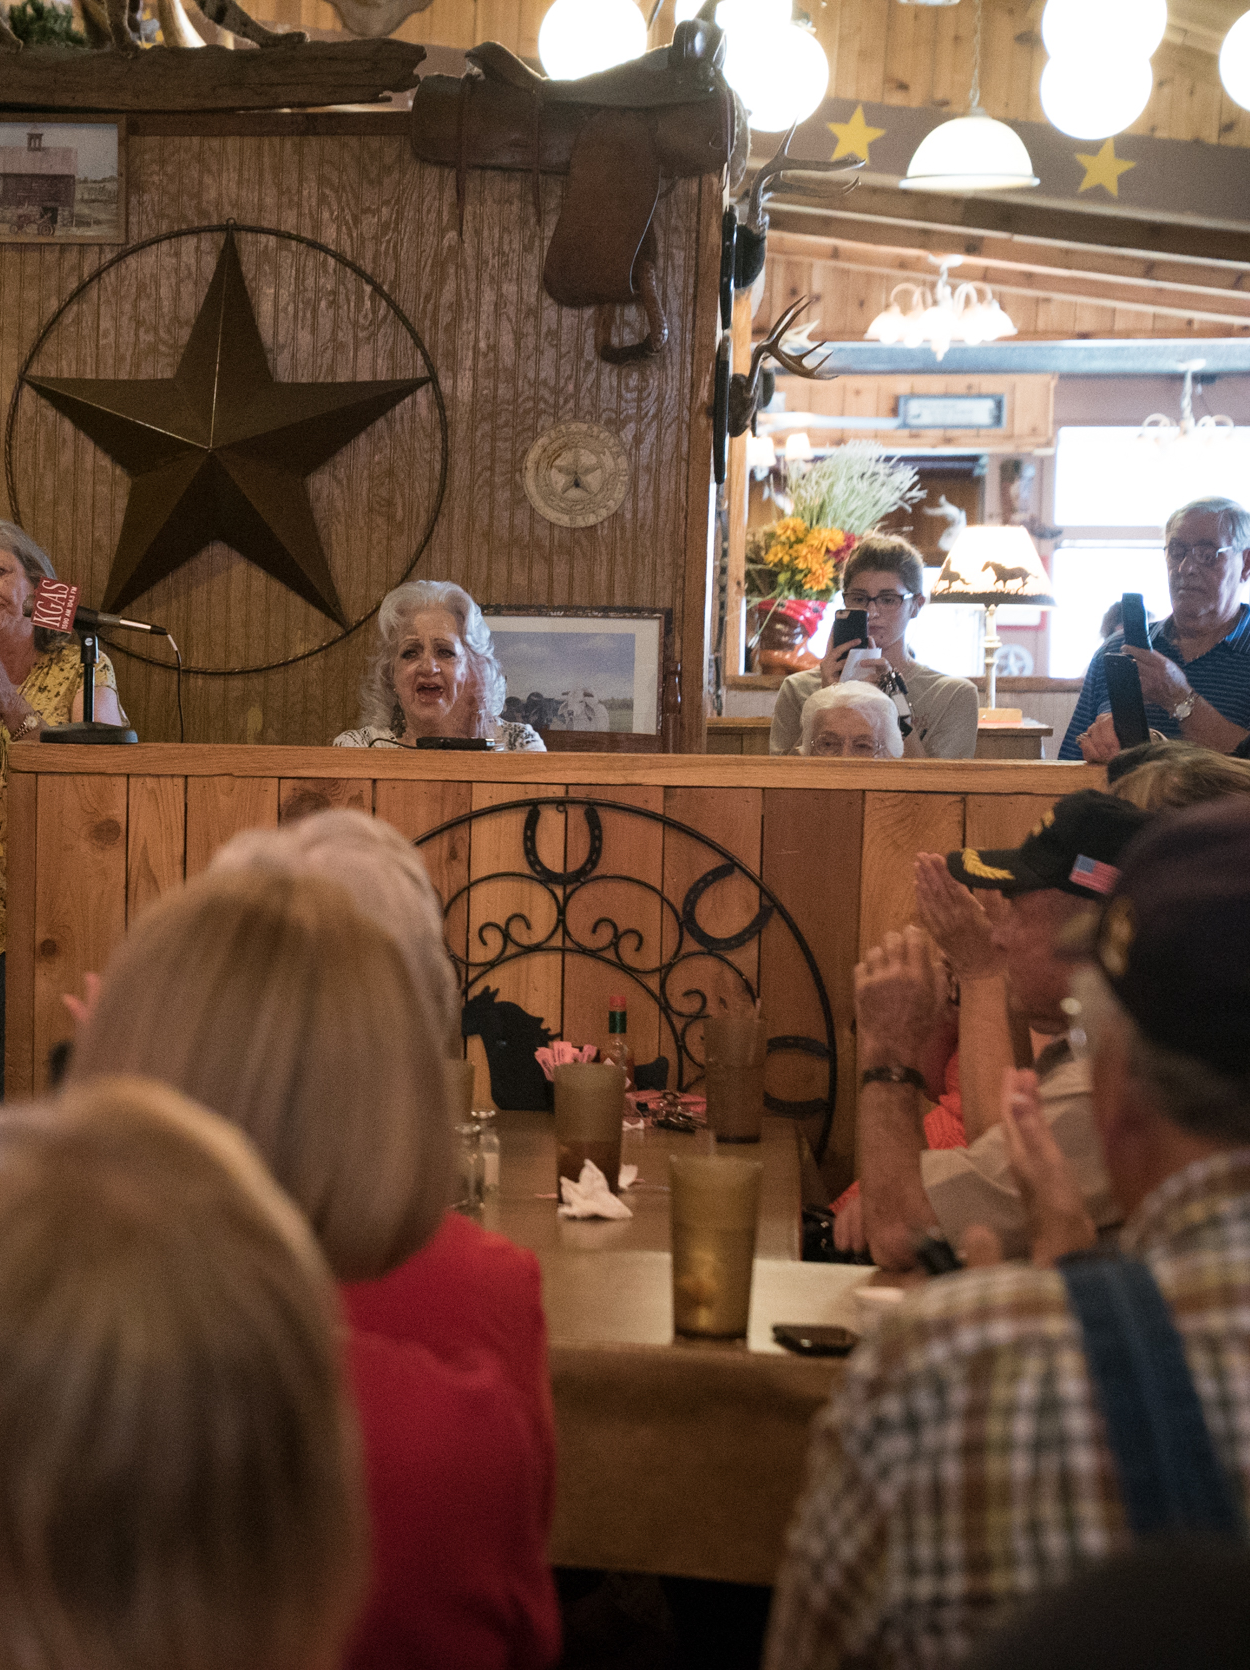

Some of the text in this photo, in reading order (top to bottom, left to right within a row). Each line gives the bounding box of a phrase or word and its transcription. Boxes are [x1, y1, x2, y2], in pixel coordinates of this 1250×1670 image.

[33, 579, 69, 627] KGAS
[61, 586, 78, 629] 1590 AM 104.3 FM
